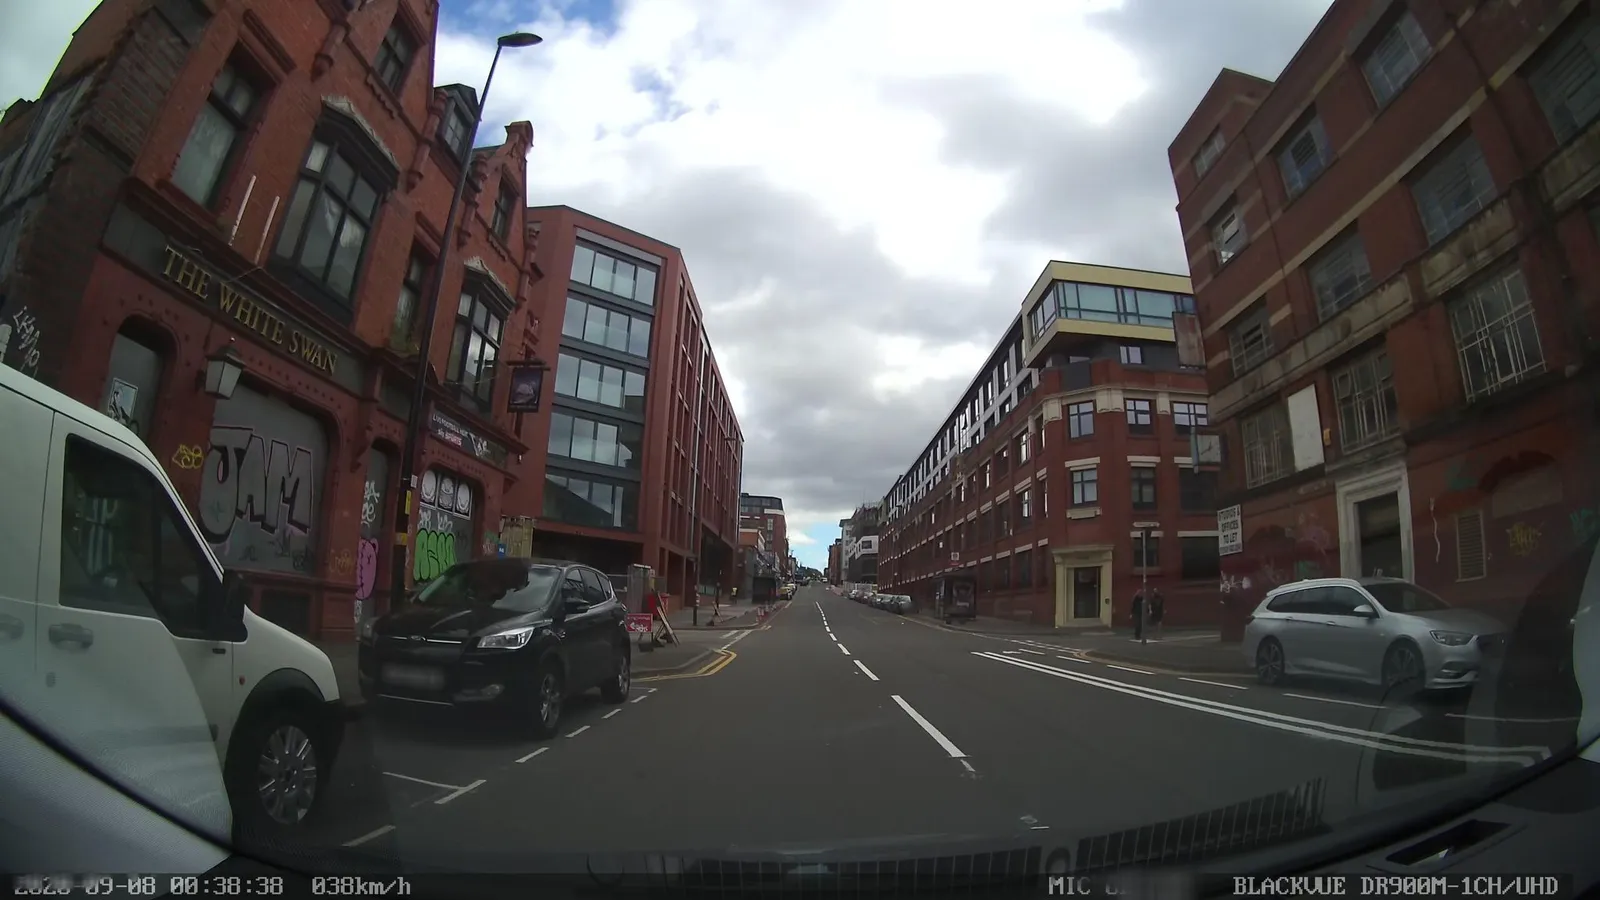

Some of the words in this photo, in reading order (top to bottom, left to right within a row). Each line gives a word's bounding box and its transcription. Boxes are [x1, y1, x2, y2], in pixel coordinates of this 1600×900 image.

[163, 244, 212, 300] THE
[219, 281, 286, 345] WHITE
[289, 330, 338, 376] SWAN
[199, 425, 313, 544] JAM
